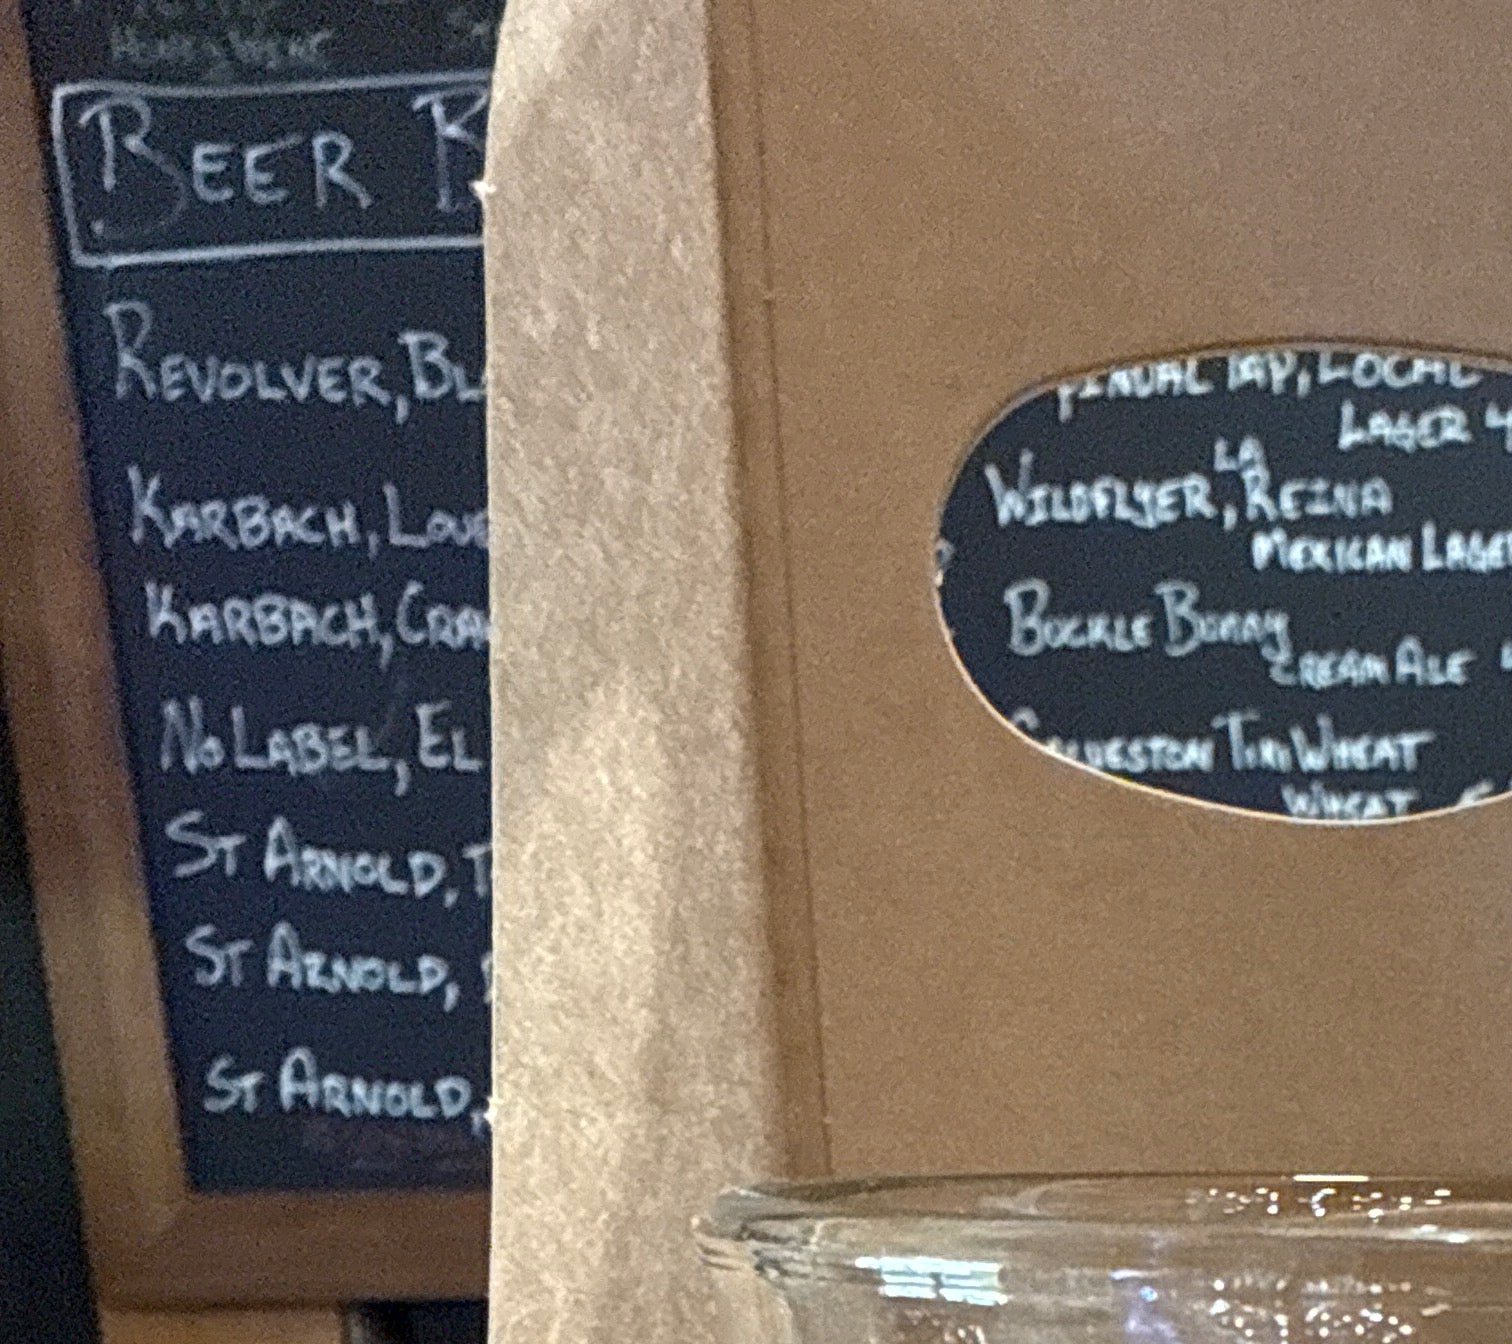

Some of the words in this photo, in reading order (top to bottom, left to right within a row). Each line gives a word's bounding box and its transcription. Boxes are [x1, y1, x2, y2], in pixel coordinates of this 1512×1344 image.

[78, 94, 372, 236] BEER
[397, 330, 487, 402] BL
[1317, 351, 1484, 390] LOCAL
[1338, 400, 1473, 453] LAGER
[1395, 633, 1478, 687] ALE
